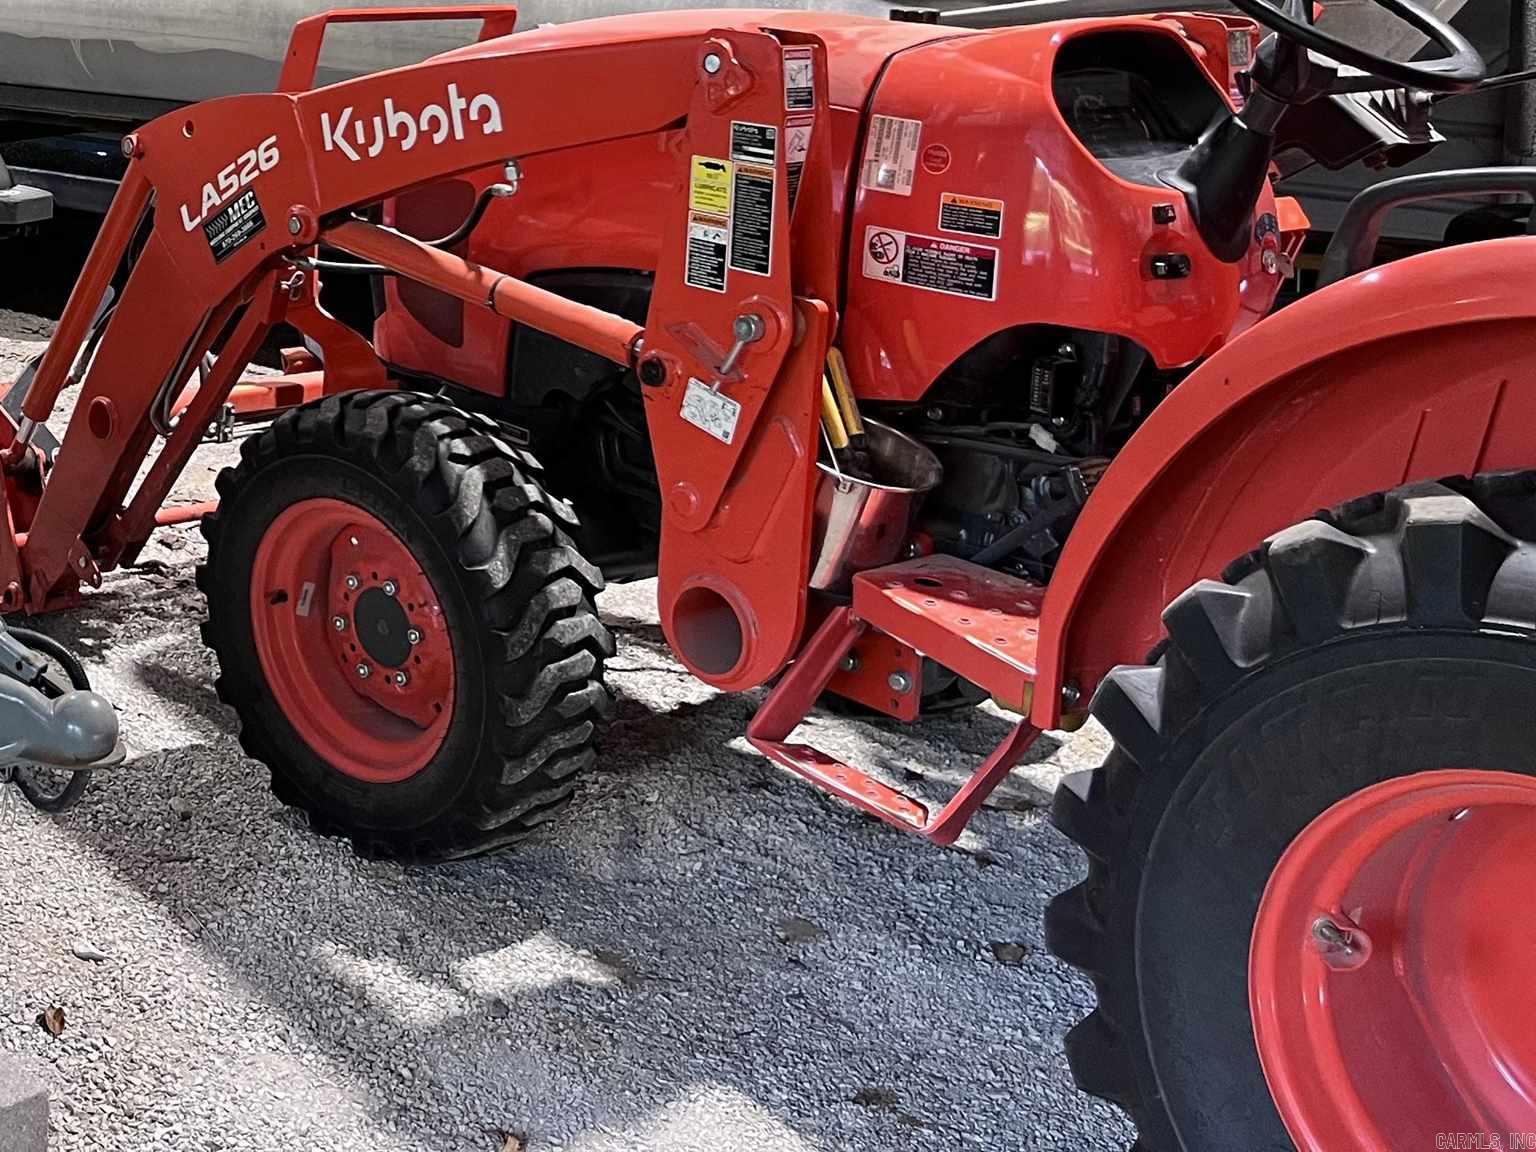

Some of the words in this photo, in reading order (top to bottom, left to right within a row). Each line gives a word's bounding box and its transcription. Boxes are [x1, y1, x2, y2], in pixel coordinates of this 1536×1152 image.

[320, 83, 504, 162] Kubota
[180, 135, 280, 232] LA526
[227, 191, 256, 223] MEC
